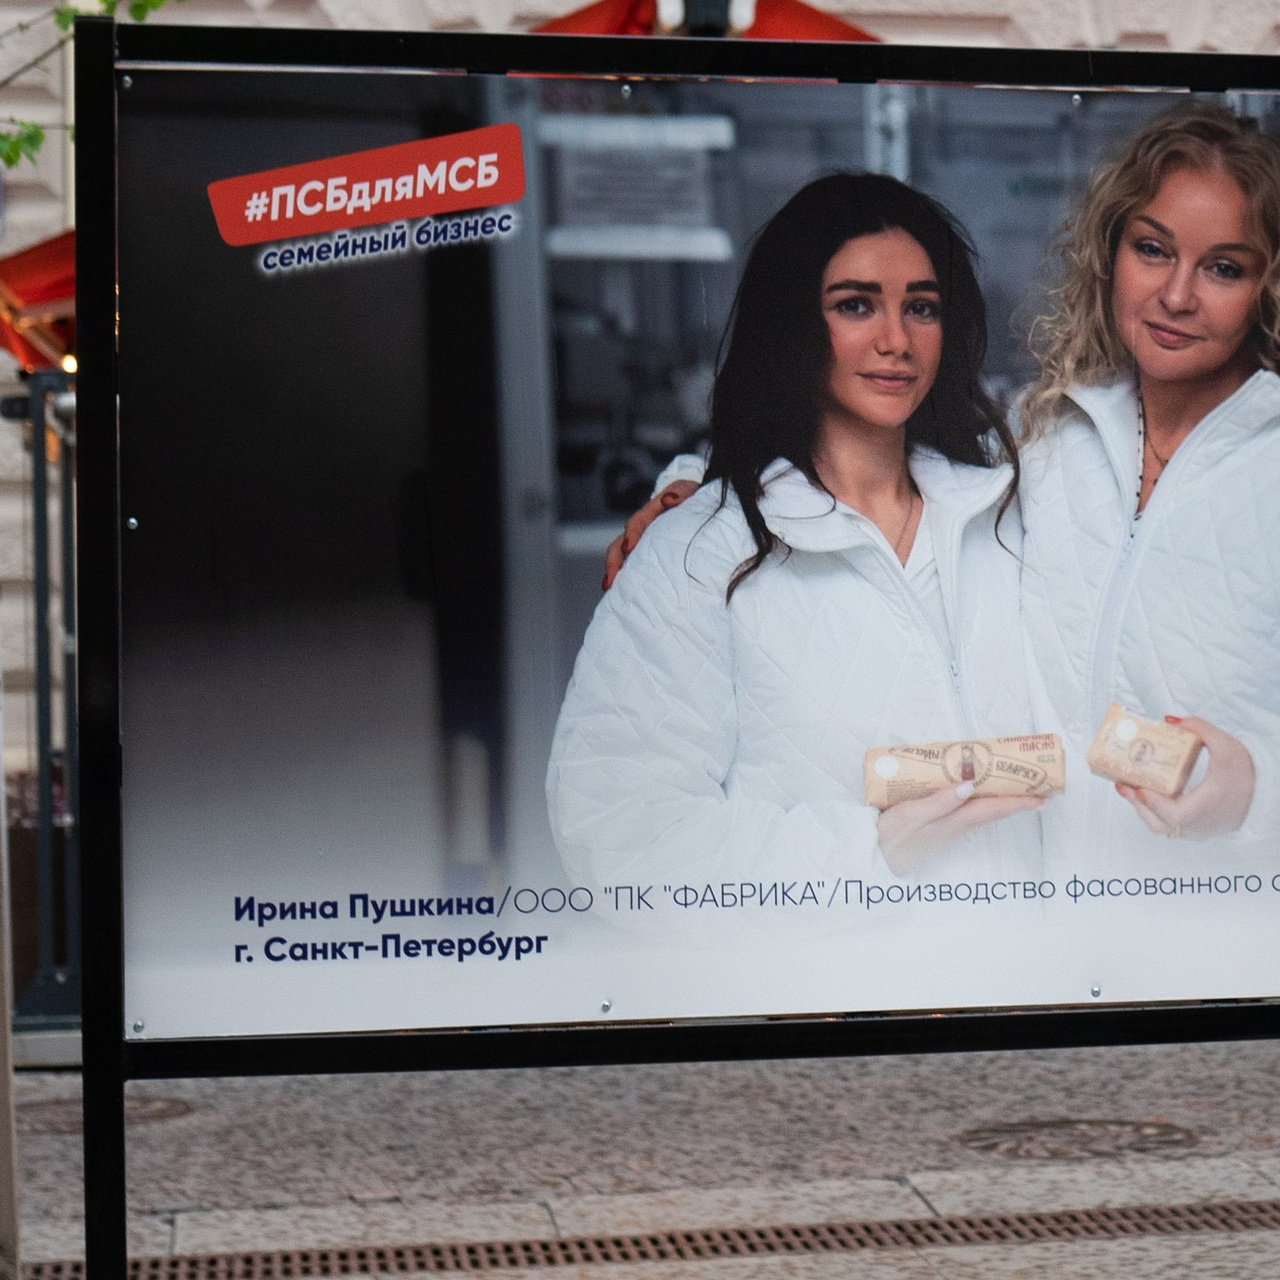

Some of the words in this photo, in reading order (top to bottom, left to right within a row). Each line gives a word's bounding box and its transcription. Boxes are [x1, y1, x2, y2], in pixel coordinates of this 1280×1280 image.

[244, 153, 501, 222] #ПСБдляМСБ
[262, 225, 407, 271] семейный
[415, 212, 513, 246] бизнес
[234, 895, 339, 927] Ирина
[348, 885, 594, 924] Пушкина/ООО
[604, 886, 654, 911] "ПК
[1065, 873, 1263, 903] фасованного
[234, 942, 254, 962] г.
[264, 931, 548, 962] Санкт-Петербург
